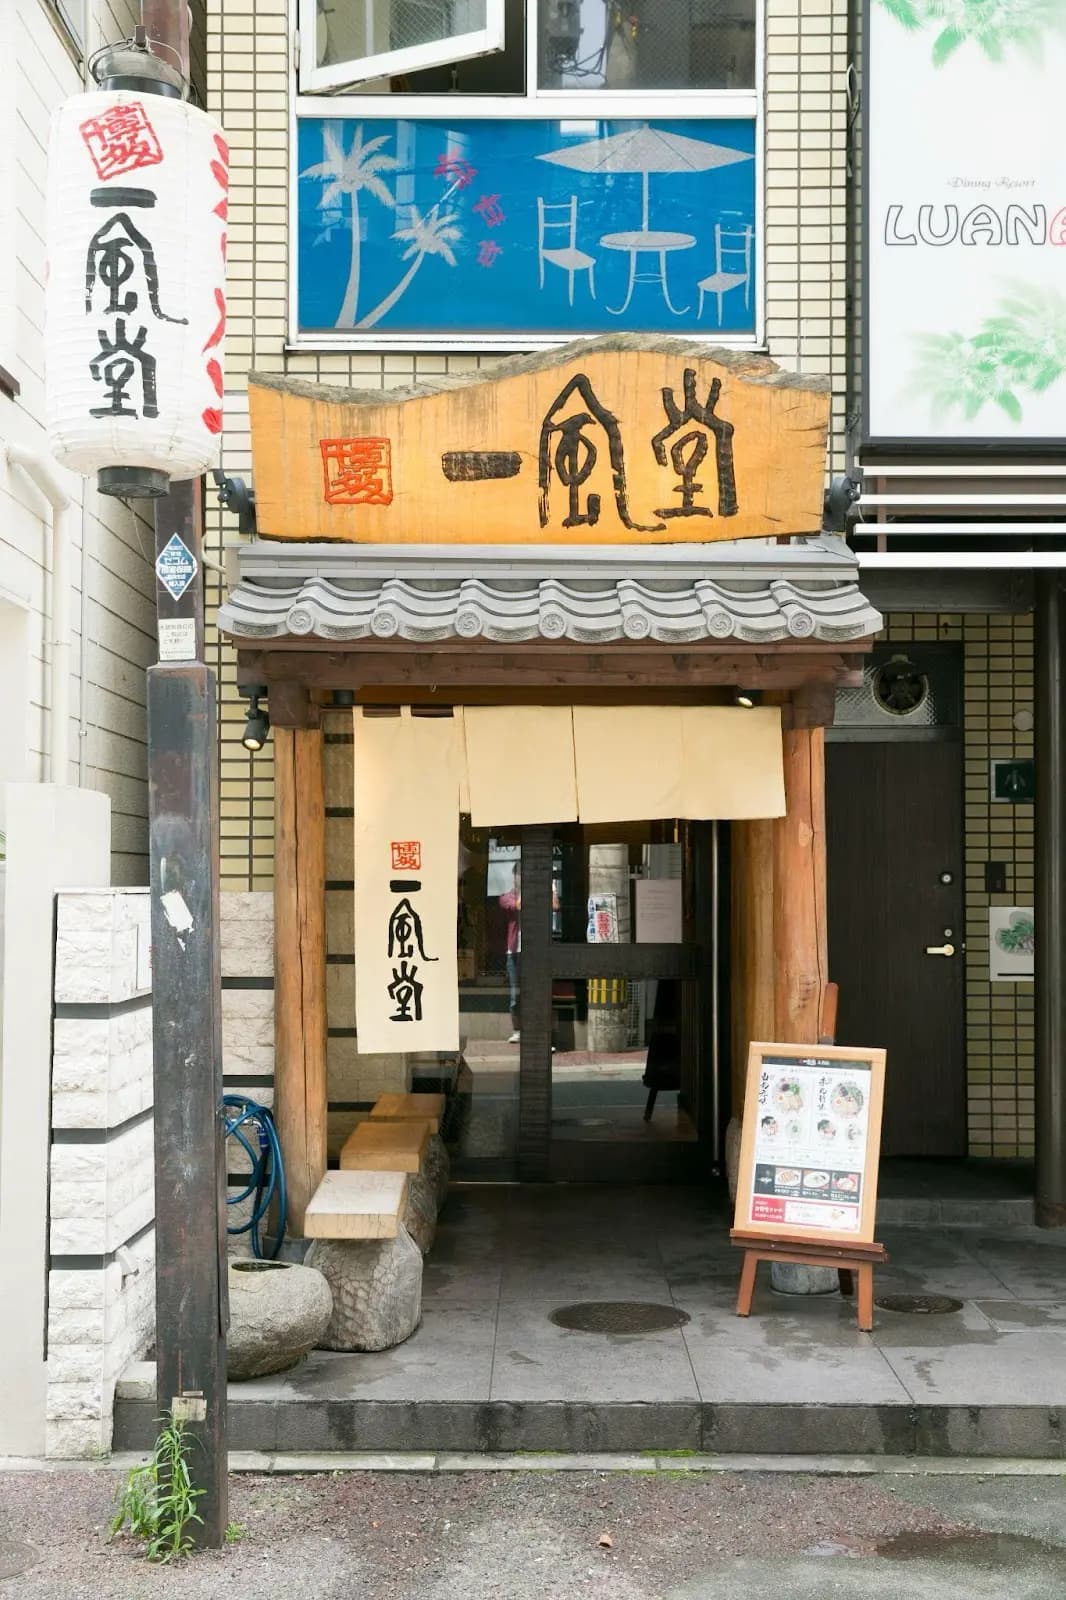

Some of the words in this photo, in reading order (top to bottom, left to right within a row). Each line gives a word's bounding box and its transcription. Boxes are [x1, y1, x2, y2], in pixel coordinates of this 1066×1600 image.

[946, 175, 992, 193] Dining
[86, 186, 189, 420] 一風堂
[441, 368, 737, 531] 一風堂
[387, 880, 439, 1021] 一風堂
